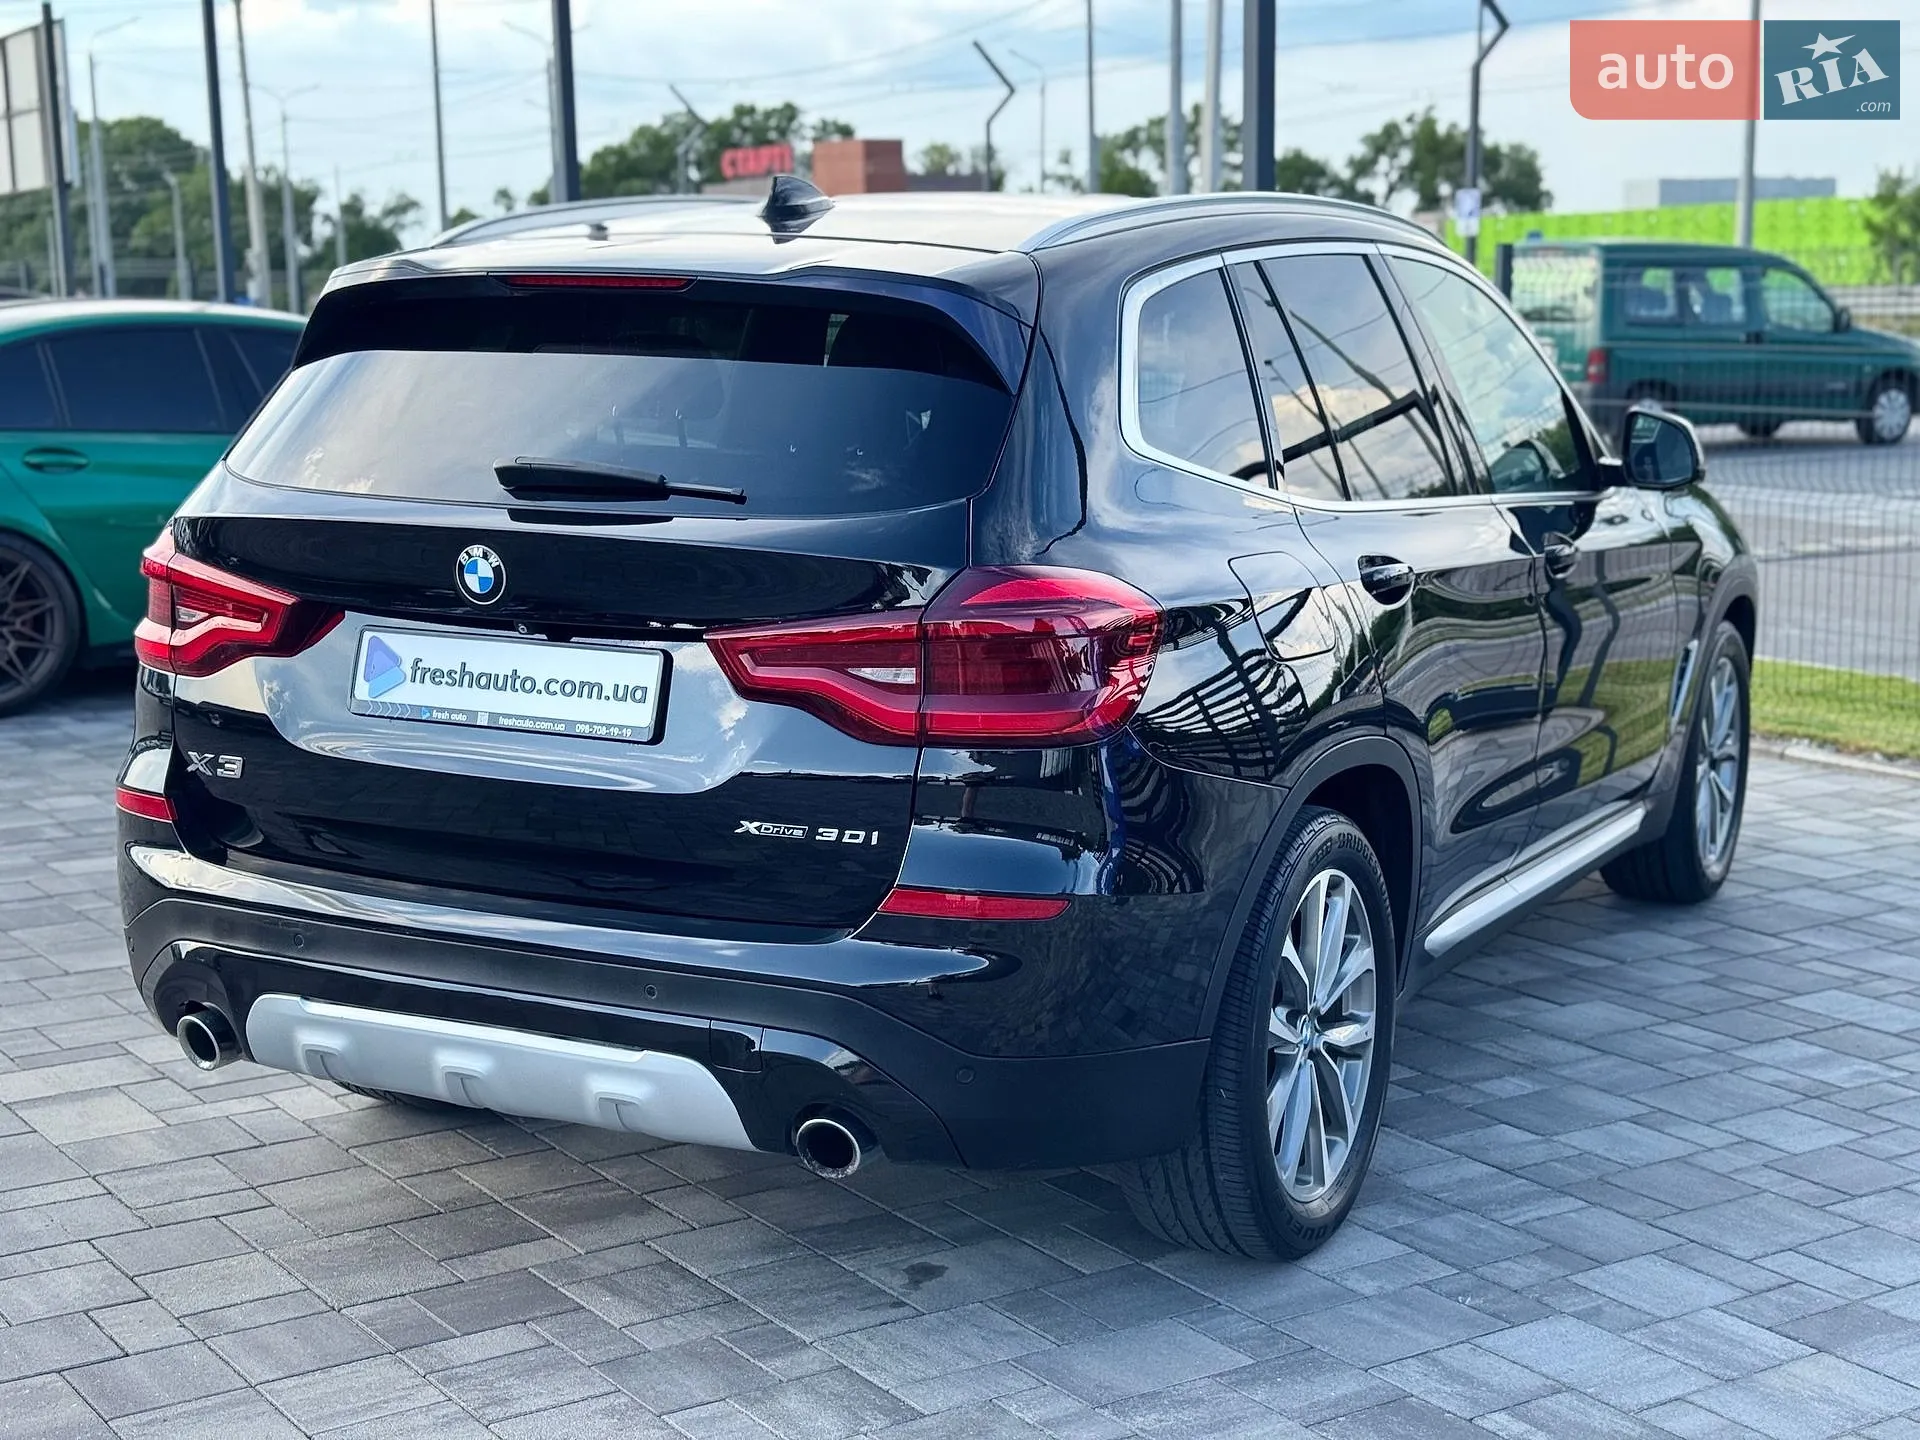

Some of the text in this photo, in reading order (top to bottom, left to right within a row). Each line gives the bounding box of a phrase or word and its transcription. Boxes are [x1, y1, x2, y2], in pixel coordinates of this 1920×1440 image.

[460, 547, 501, 568] BMW
[409, 657, 648, 704] freshauto.com.ua
[432, 709, 468, 721] fresh auto
[186, 751, 243, 779] X3
